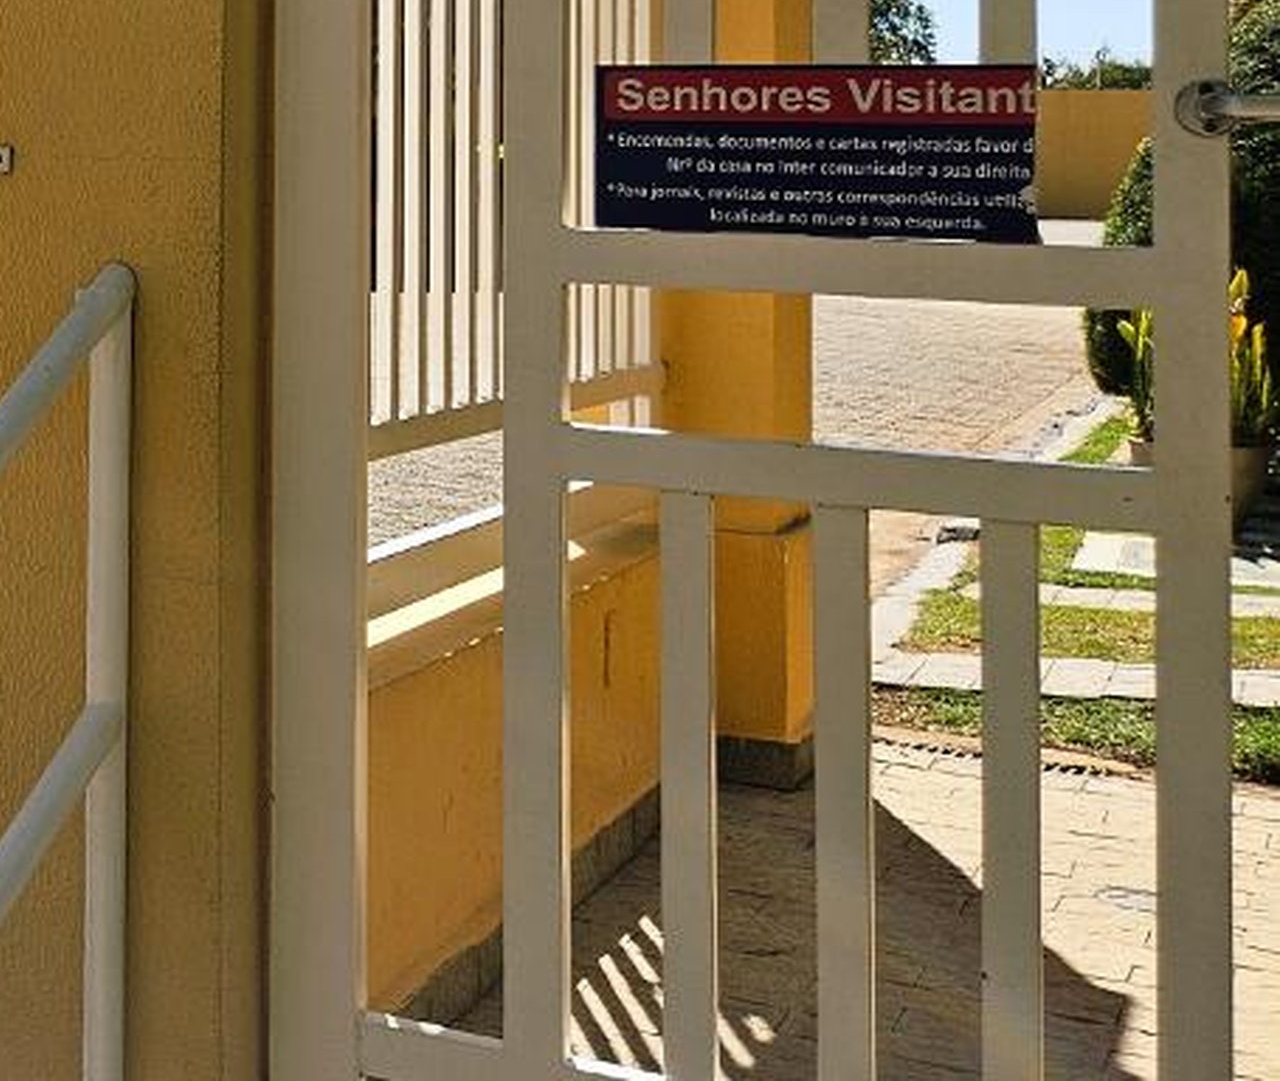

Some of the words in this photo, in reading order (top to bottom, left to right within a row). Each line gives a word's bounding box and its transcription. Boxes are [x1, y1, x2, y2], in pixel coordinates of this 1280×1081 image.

[616, 77, 832, 113] Senhores
[846, 78, 1037, 115] Visitant
[718, 134, 812, 151] documentos
[815, 138, 826, 151] e
[882, 134, 972, 156] registradas
[975, 137, 1018, 153] favor
[696, 158, 716, 173] da
[719, 160, 752, 174] casa
[755, 162, 775, 174] no
[820, 159, 923, 177] comunicador
[942, 165, 972, 178] sua
[769, 189, 781, 201] e
[788, 213, 809, 225] no
[812, 213, 856, 227] muro
[873, 215, 901, 229] sua
